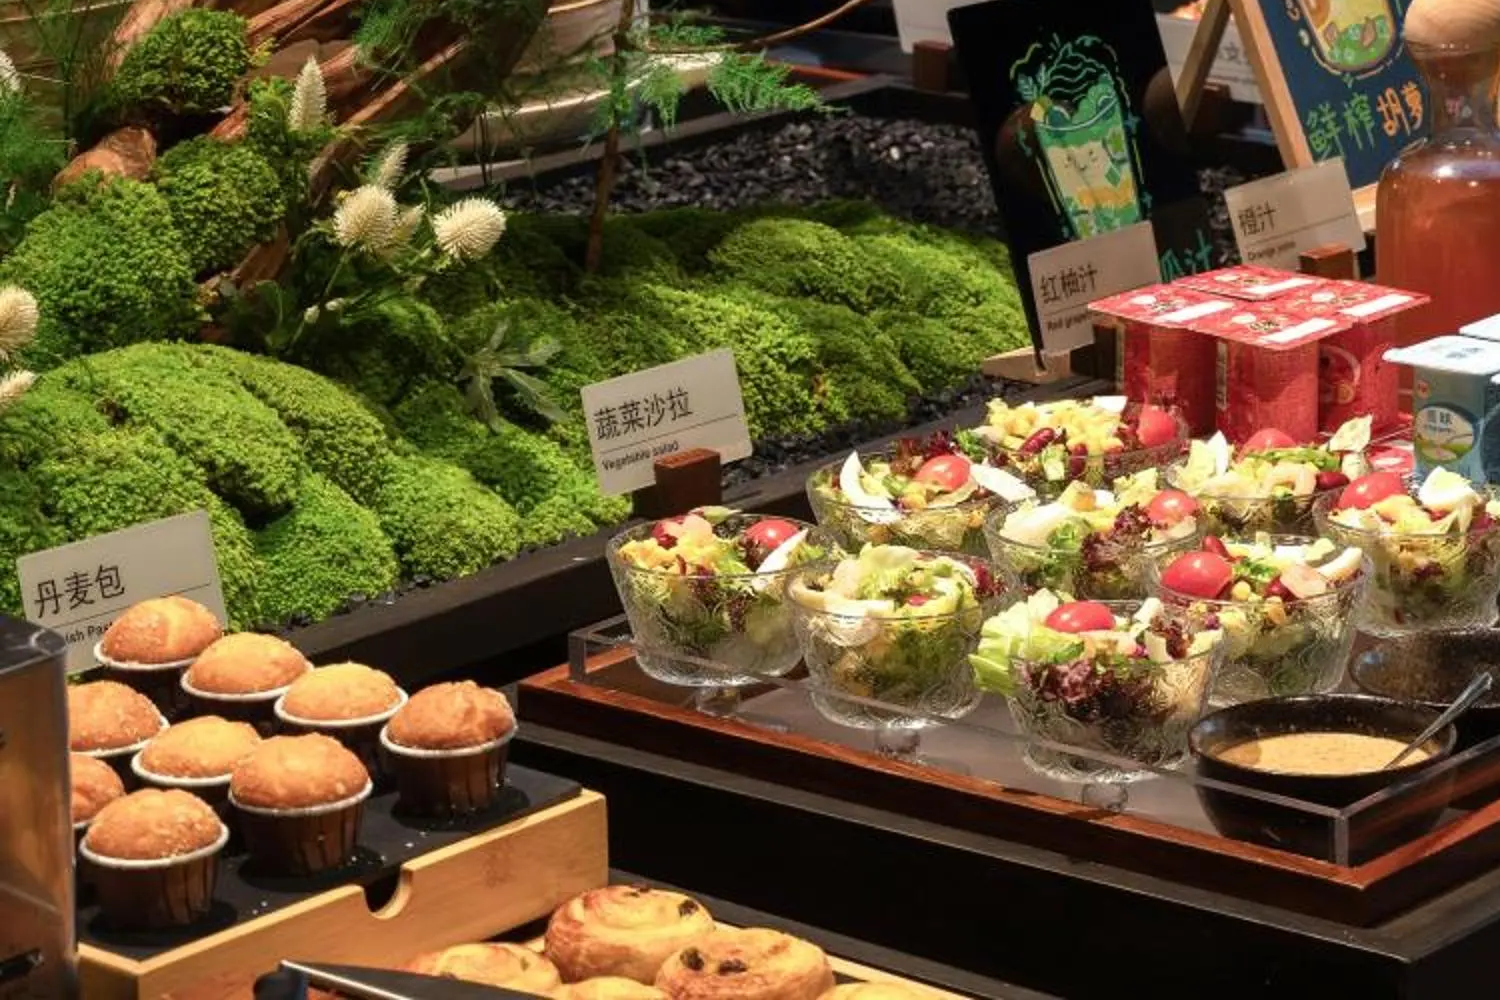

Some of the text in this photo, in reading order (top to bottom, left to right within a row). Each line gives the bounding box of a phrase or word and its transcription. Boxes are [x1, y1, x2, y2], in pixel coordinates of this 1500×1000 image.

[593, 385, 693, 440] 蔬菜沙拉
[34, 564, 125, 619] 丹麦包
[65, 629, 85, 642] ish
